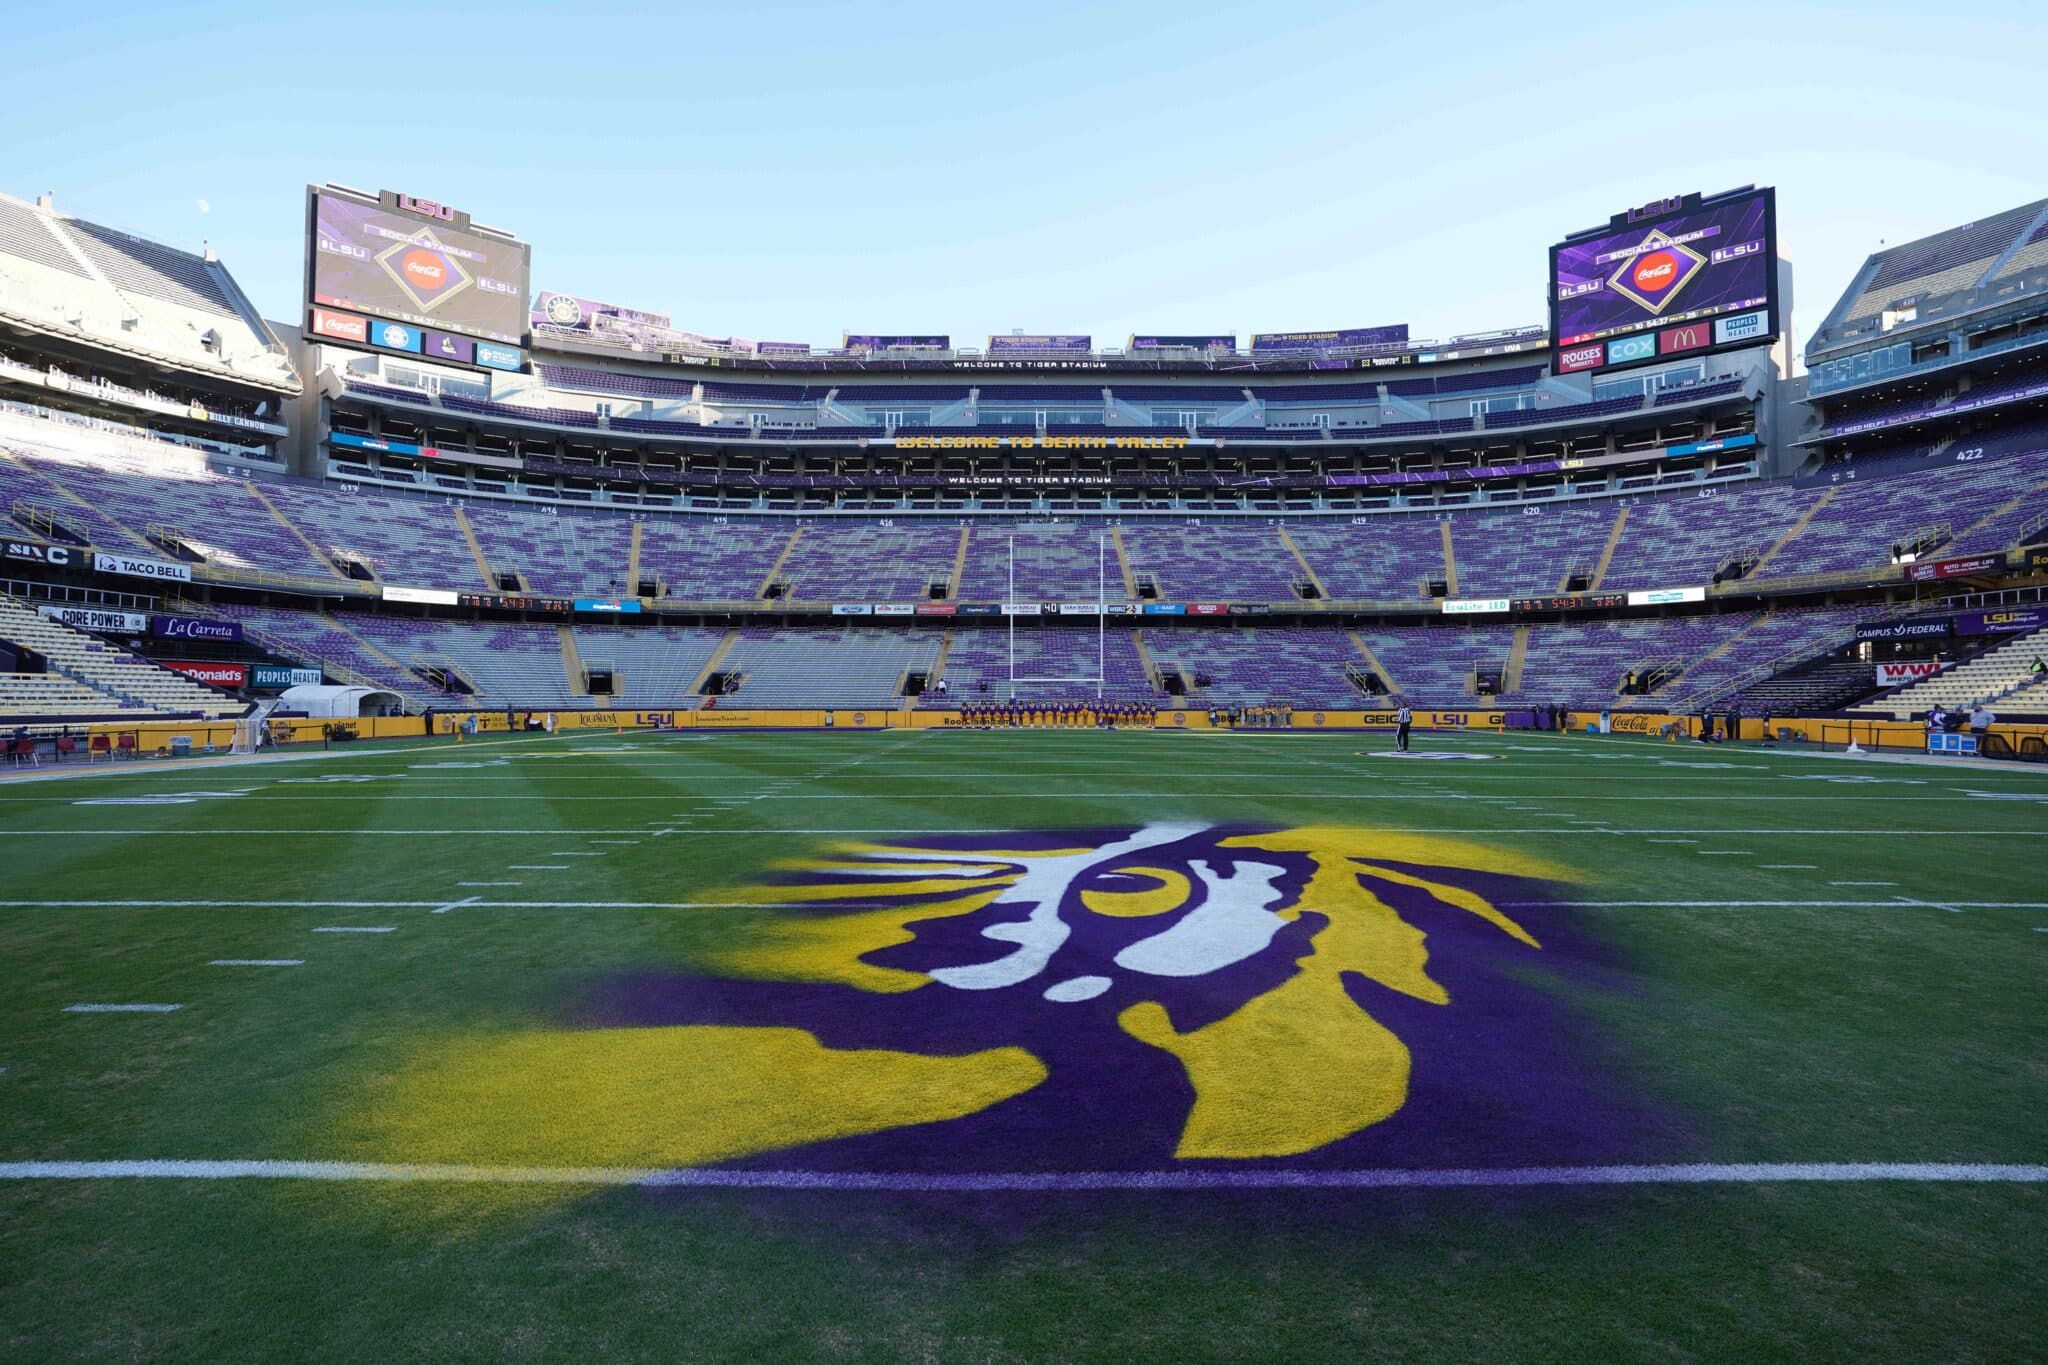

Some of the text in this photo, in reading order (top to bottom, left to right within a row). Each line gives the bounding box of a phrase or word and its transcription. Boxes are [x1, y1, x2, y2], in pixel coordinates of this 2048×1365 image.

[400, 193, 453, 221] LSU
[1628, 195, 1681, 223] LSU
[329, 241, 365, 257] LSU
[1610, 231, 1703, 260] SOCIAL STADIUM
[1723, 242, 1759, 258] LSU
[1568, 281, 1598, 295] LSU
[1727, 316, 1757, 329] PEOPLES
[1504, 344, 1521, 353] UVA
[1610, 340, 1652, 359] COX
[1562, 347, 1601, 365] ROUSES
[235, 417, 265, 430] CANNON
[896, 437, 1188, 449] WELCOME TO DEATH VALLEY
[1957, 448, 1983, 461] 422
[1699, 488, 1717, 498] 421
[1523, 507, 1540, 515] 420
[880, 519, 894, 527] 416
[1352, 517, 1367, 525] 419
[122, 561, 186, 579] TACO BELL
[1044, 603, 1057, 613] 40
[62, 610, 125, 628] CORE POWER
[165, 619, 232, 638] La Carreta
[1856, 625, 1946, 639] CAMPUS FEDERAL
[257, 669, 321, 683] PEOPLES HEALTH
[636, 713, 673, 725] LSU
[1364, 714, 1412, 725] GEIC
[1432, 714, 1469, 725] LSU
